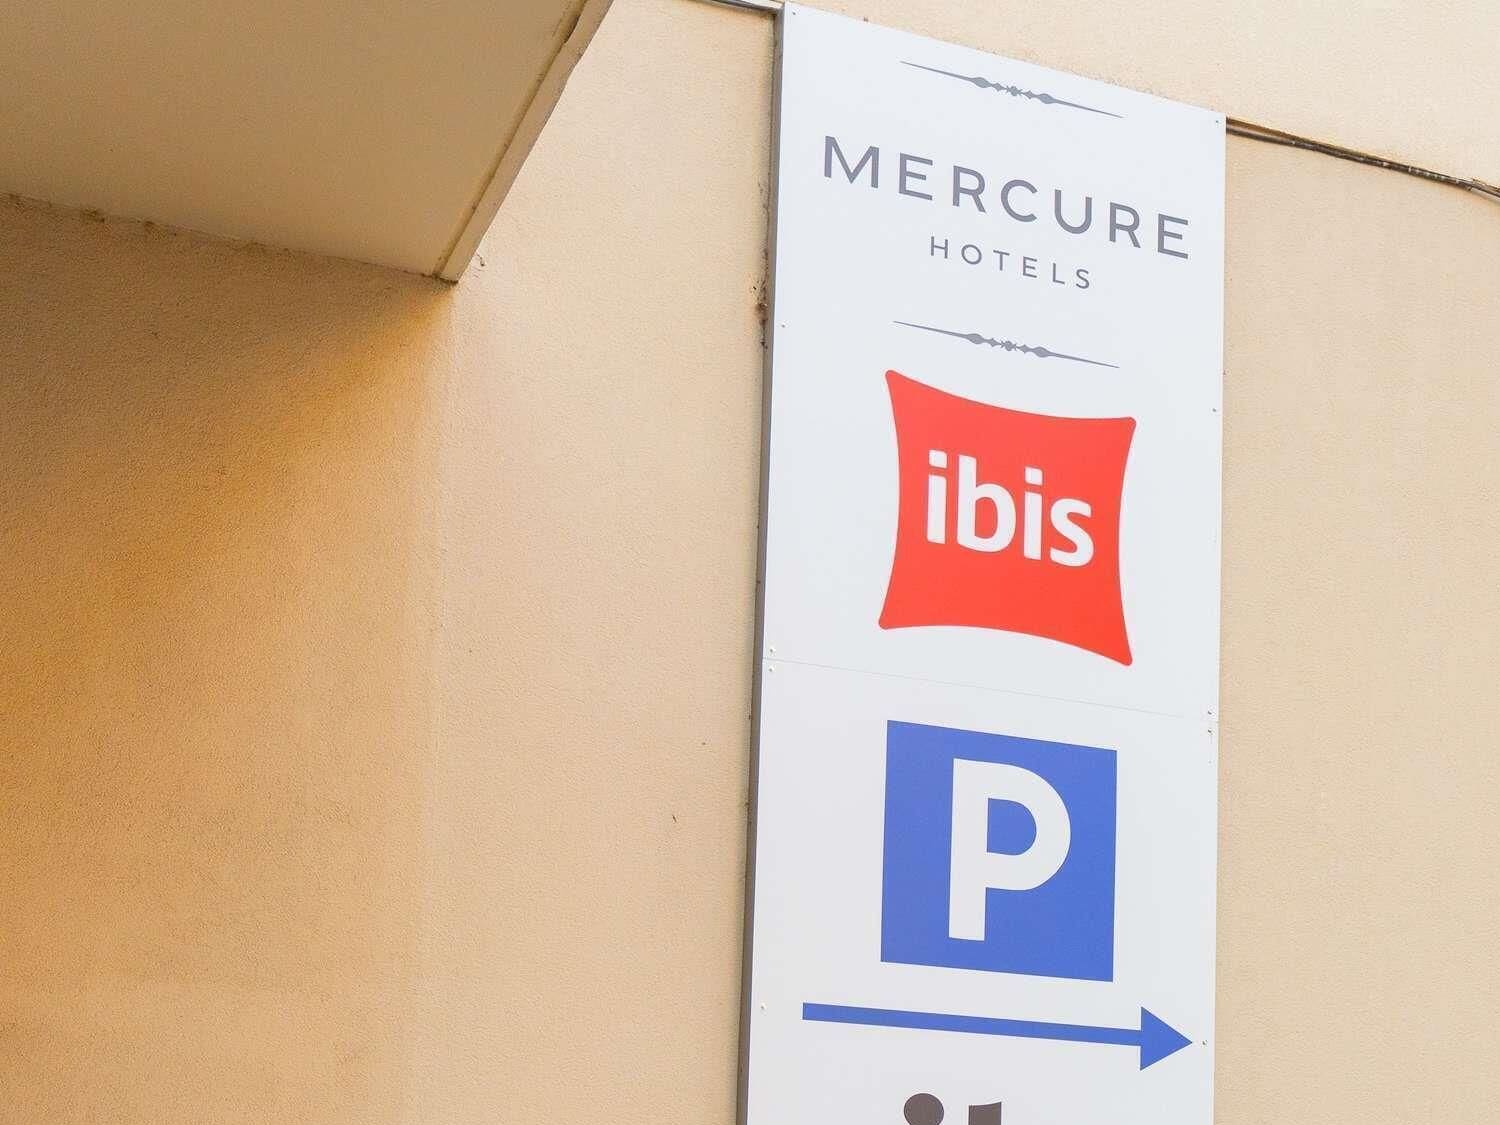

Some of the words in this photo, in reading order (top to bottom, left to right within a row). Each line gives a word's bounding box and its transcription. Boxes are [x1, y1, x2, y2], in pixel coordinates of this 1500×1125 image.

[822, 134, 1190, 260] MERCURE
[929, 235, 1091, 290] HOTELS
[925, 448, 1095, 567] ibis
[948, 757, 1072, 942] P
